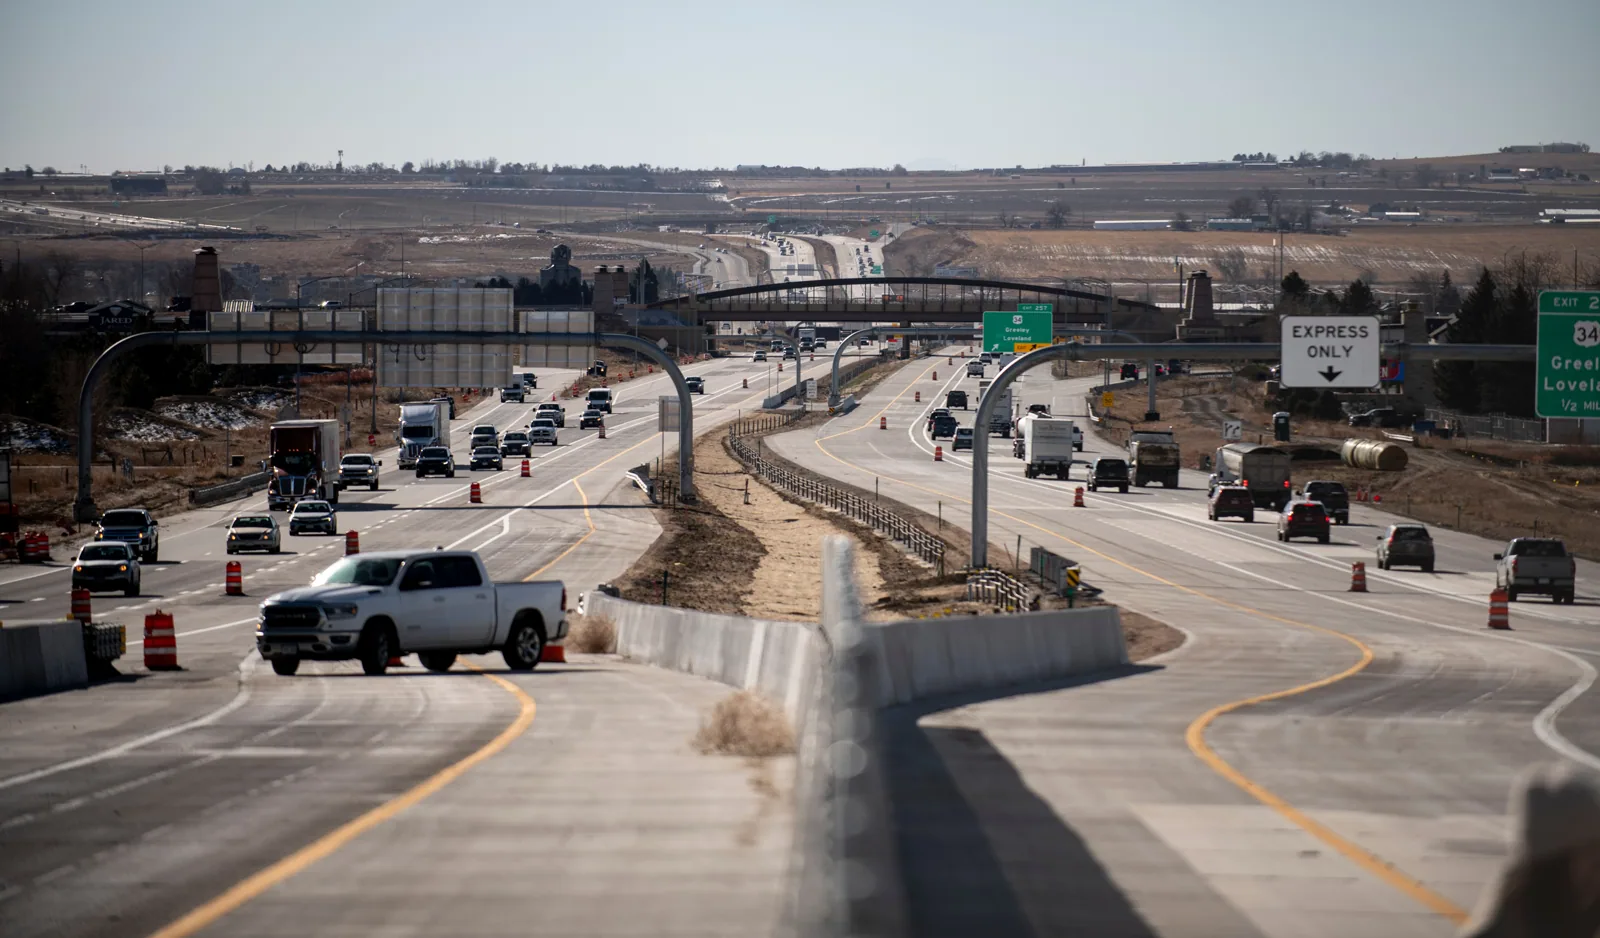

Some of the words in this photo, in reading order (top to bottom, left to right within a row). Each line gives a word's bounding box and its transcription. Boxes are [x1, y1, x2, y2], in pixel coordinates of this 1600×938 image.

[1553, 298, 1579, 307] EXIT
[100, 316, 132, 325] JARED
[1292, 325, 1369, 338] EXPRESS
[1576, 326, 1599, 342] 34
[1307, 345, 1354, 358] ONLY
